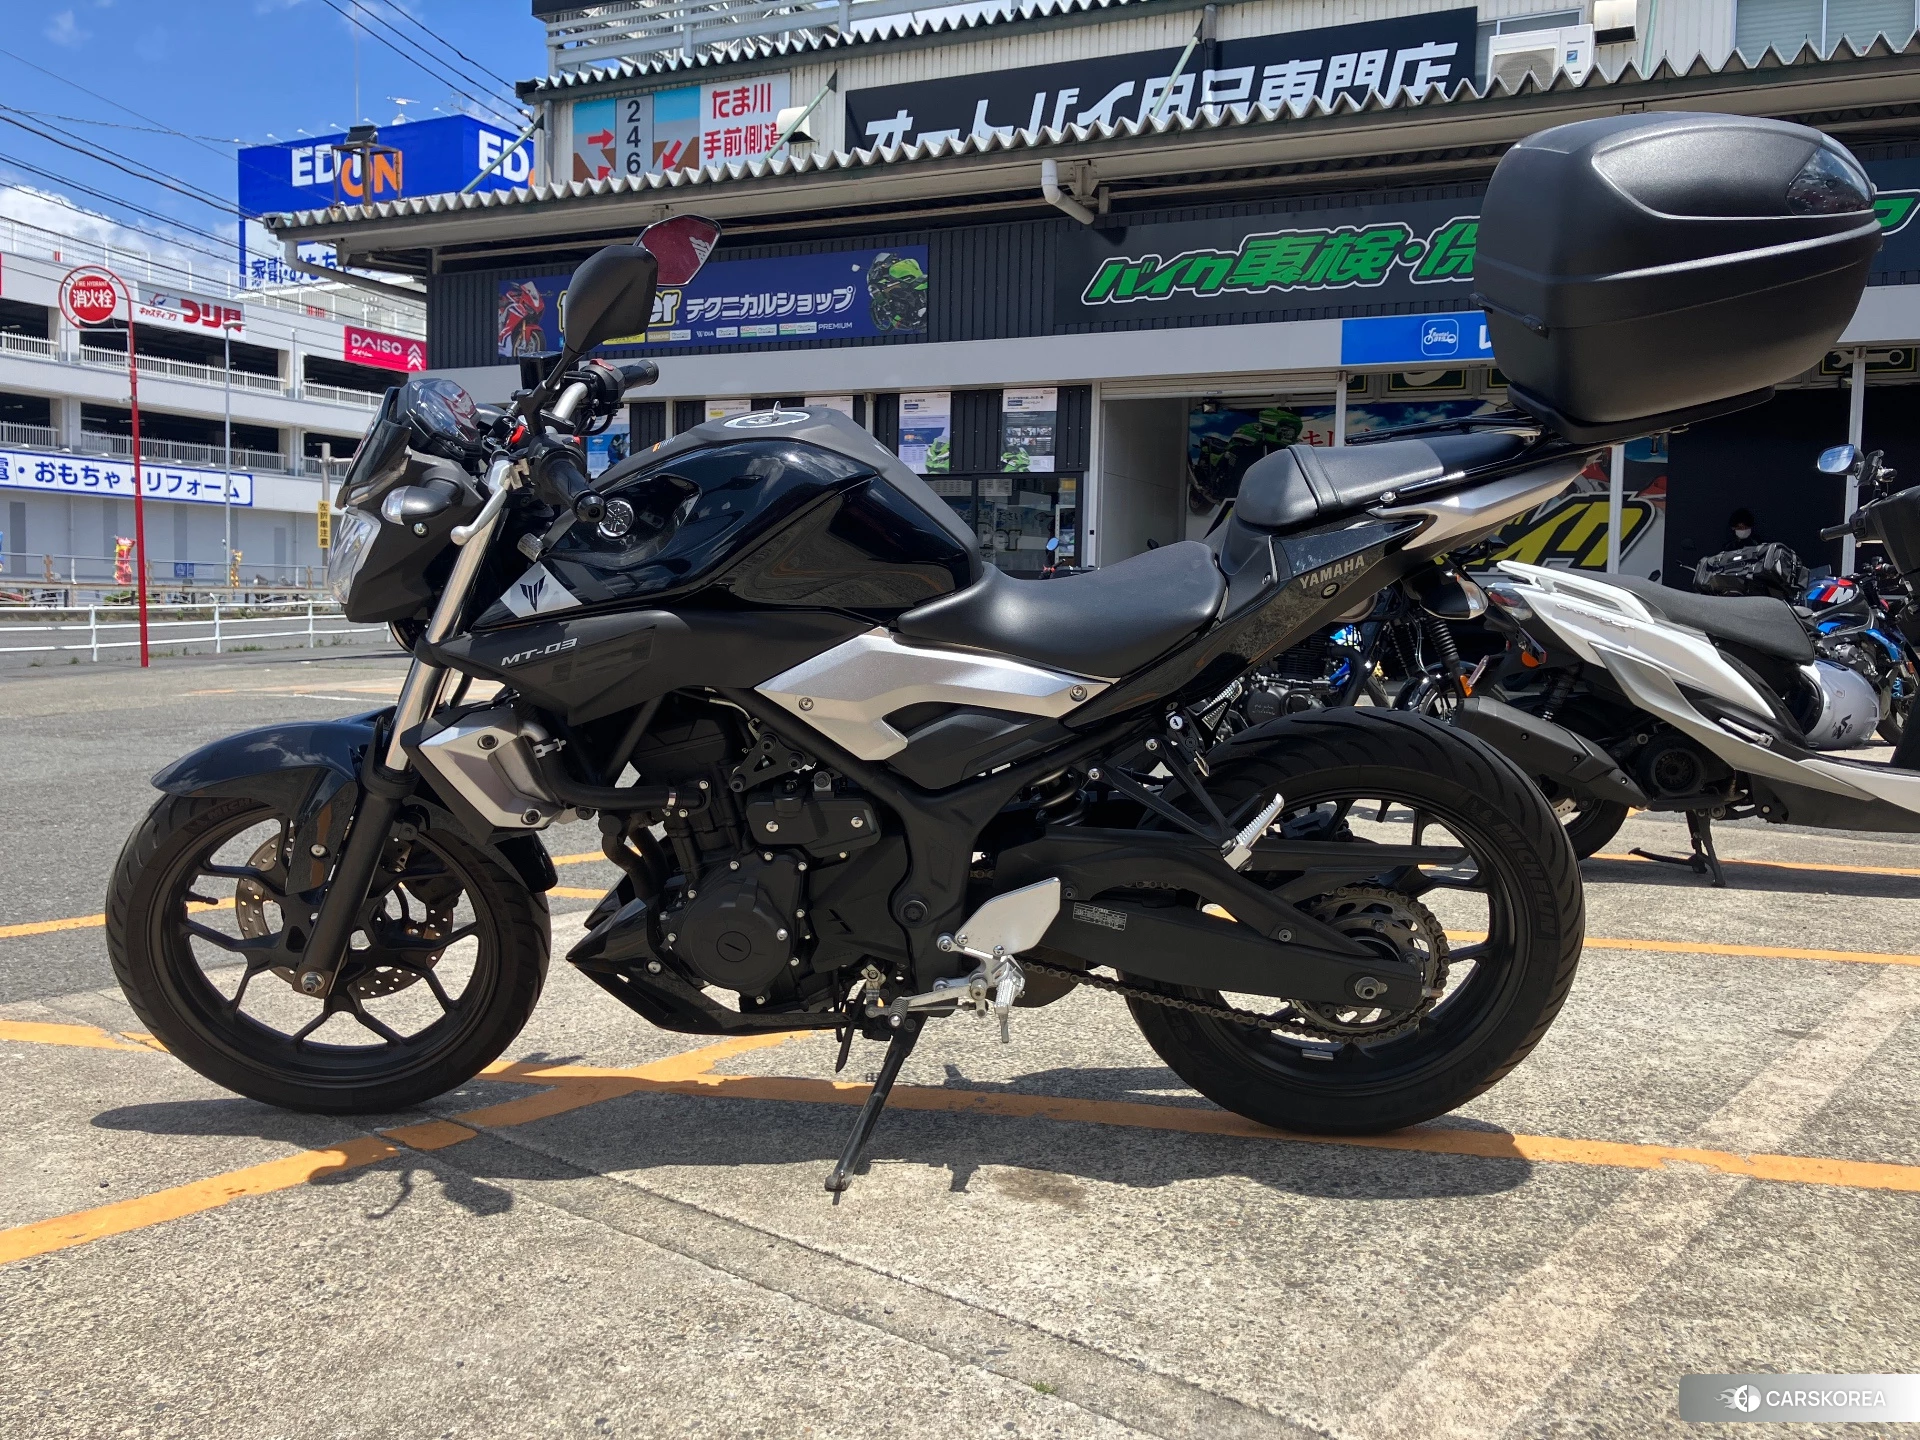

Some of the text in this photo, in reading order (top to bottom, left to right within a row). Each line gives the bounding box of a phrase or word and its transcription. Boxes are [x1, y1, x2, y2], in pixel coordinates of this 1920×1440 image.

[711, 82, 772, 119] たま川
[626, 99, 642, 175] 246
[478, 129, 535, 186] ED
[72, 288, 114, 309] 消火栓
[685, 284, 857, 323] テクニカルショップ
[817, 321, 853, 331] PREMIUM
[351, 333, 403, 356] DAISO
[1299, 555, 1365, 590] YAMAHA
[500, 637, 578, 667] MT-03
[1491, 822, 1558, 936] MICHELIN
